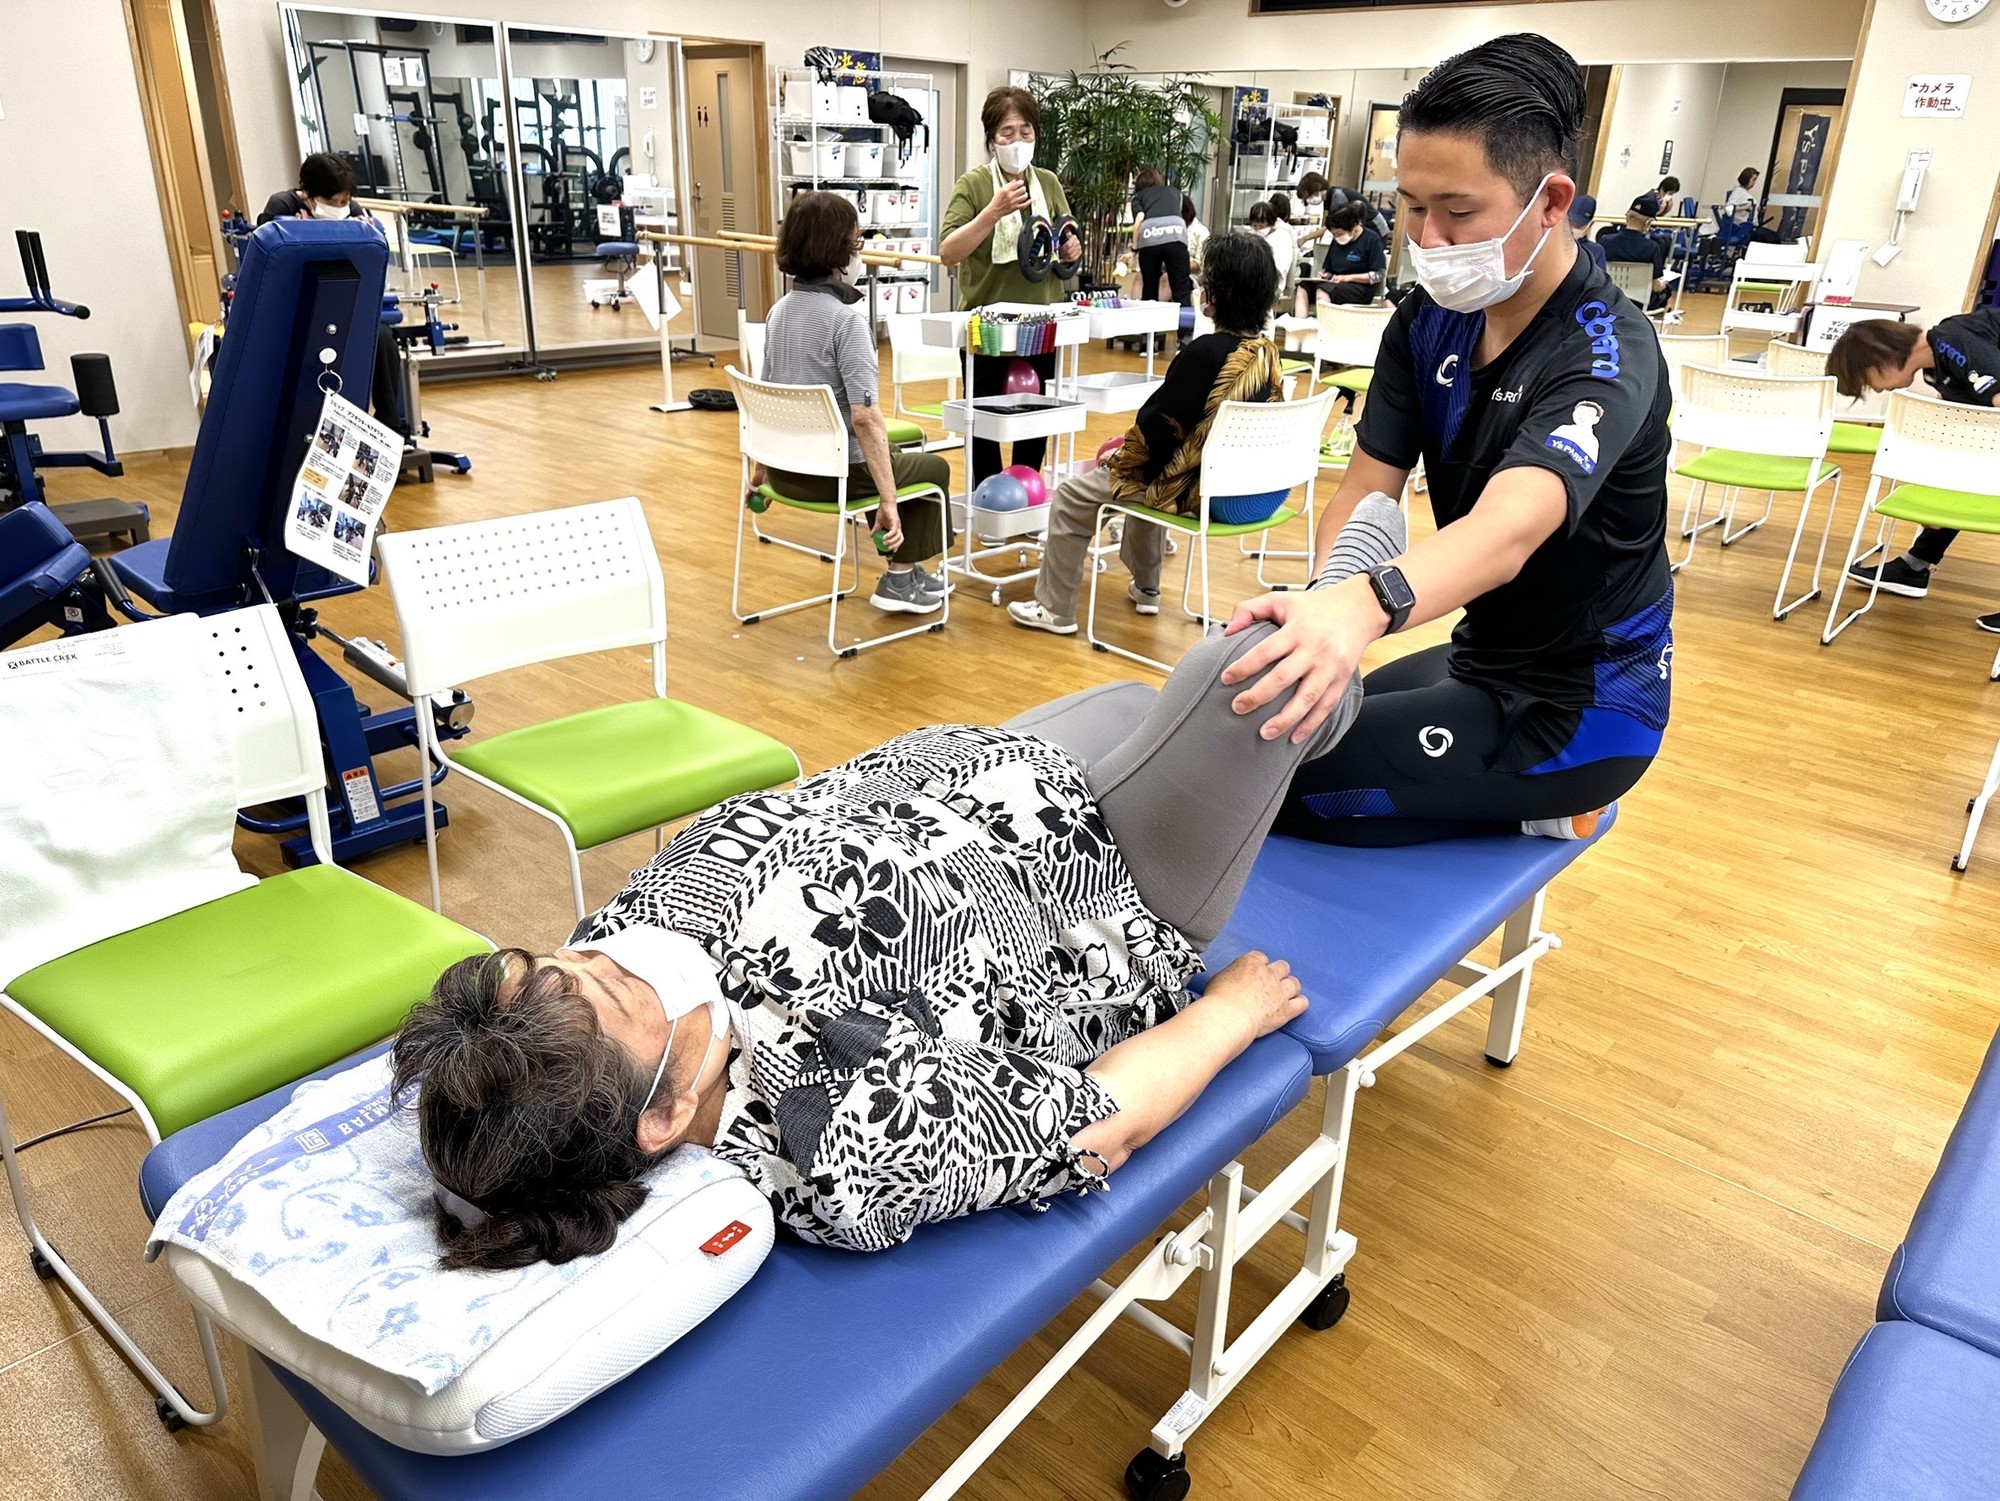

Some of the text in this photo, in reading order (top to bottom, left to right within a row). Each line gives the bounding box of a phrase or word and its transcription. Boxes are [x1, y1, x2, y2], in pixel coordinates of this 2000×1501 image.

[1939, 5, 1948, 15] 7
[1951, 7, 1957, 15] 6
[1963, 4, 1969, 13] 5
[1918, 82, 1955, 94] カメラ
[1914, 96, 1951, 108] 作動中
[1826, 327, 1845, 335] アルコ
[19, 656, 52, 667] BATTLE
